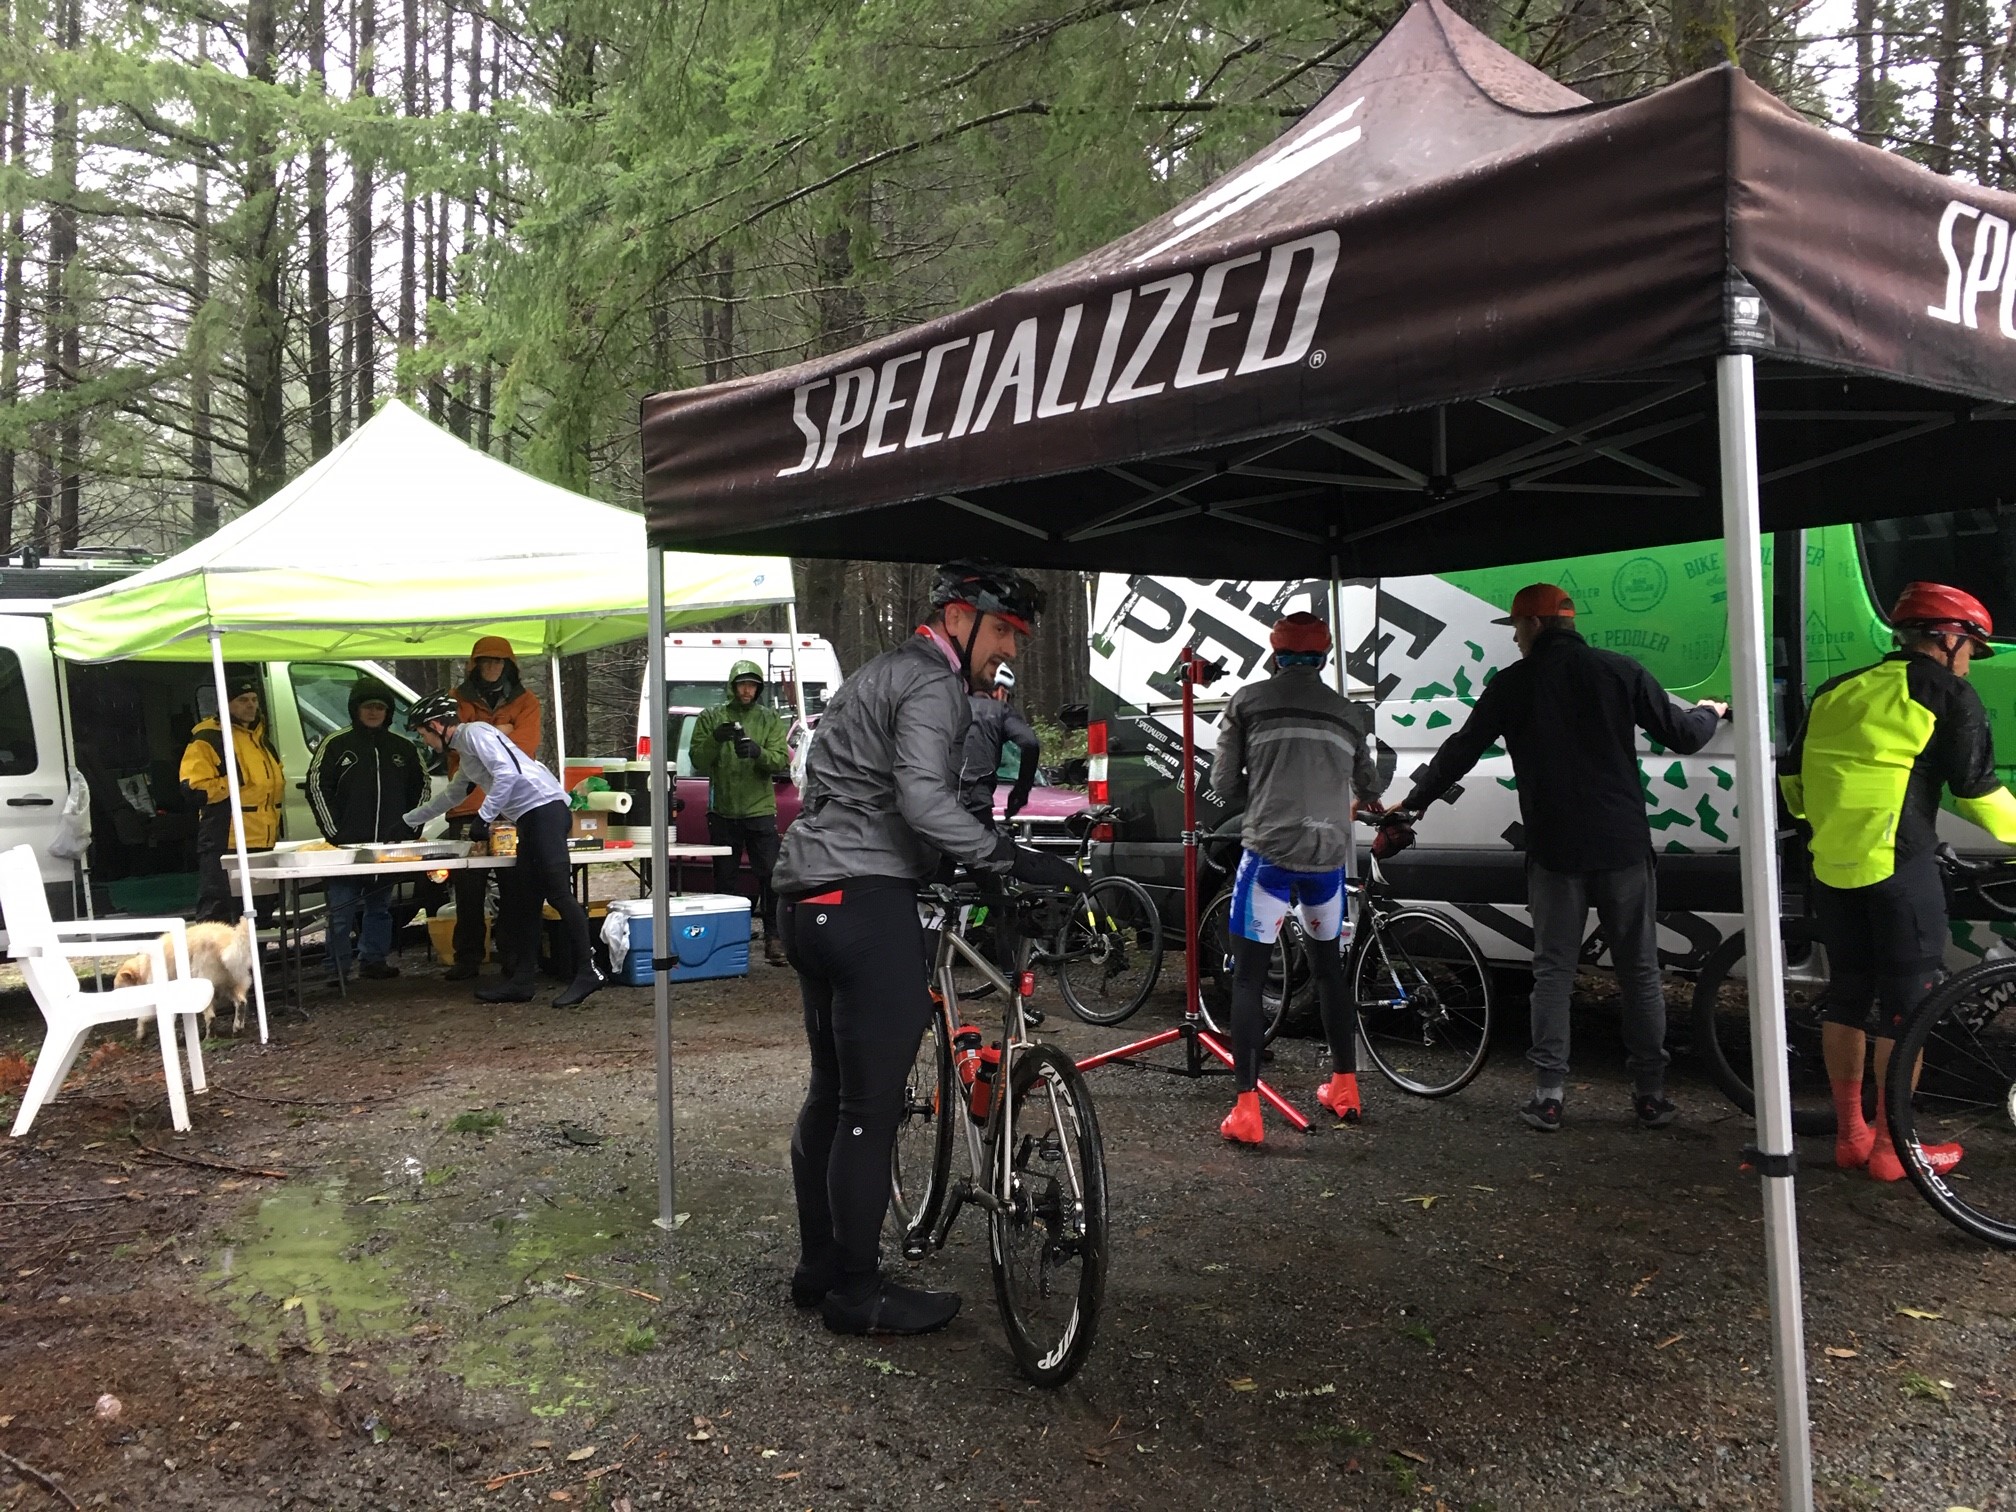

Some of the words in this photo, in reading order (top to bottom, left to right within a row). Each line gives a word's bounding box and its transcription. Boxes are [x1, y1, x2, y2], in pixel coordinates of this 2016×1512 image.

[776, 229, 1341, 478] SPECIALIZED
[1684, 553, 1720, 579] BIKE
[1605, 629, 1670, 653] PEDDLER
[1138, 720, 1168, 743] SPECIALIZED
[1146, 743, 1180, 768] SRAM
[1193, 755, 1211, 769] CRUZ
[1201, 789, 1226, 808] ibis
